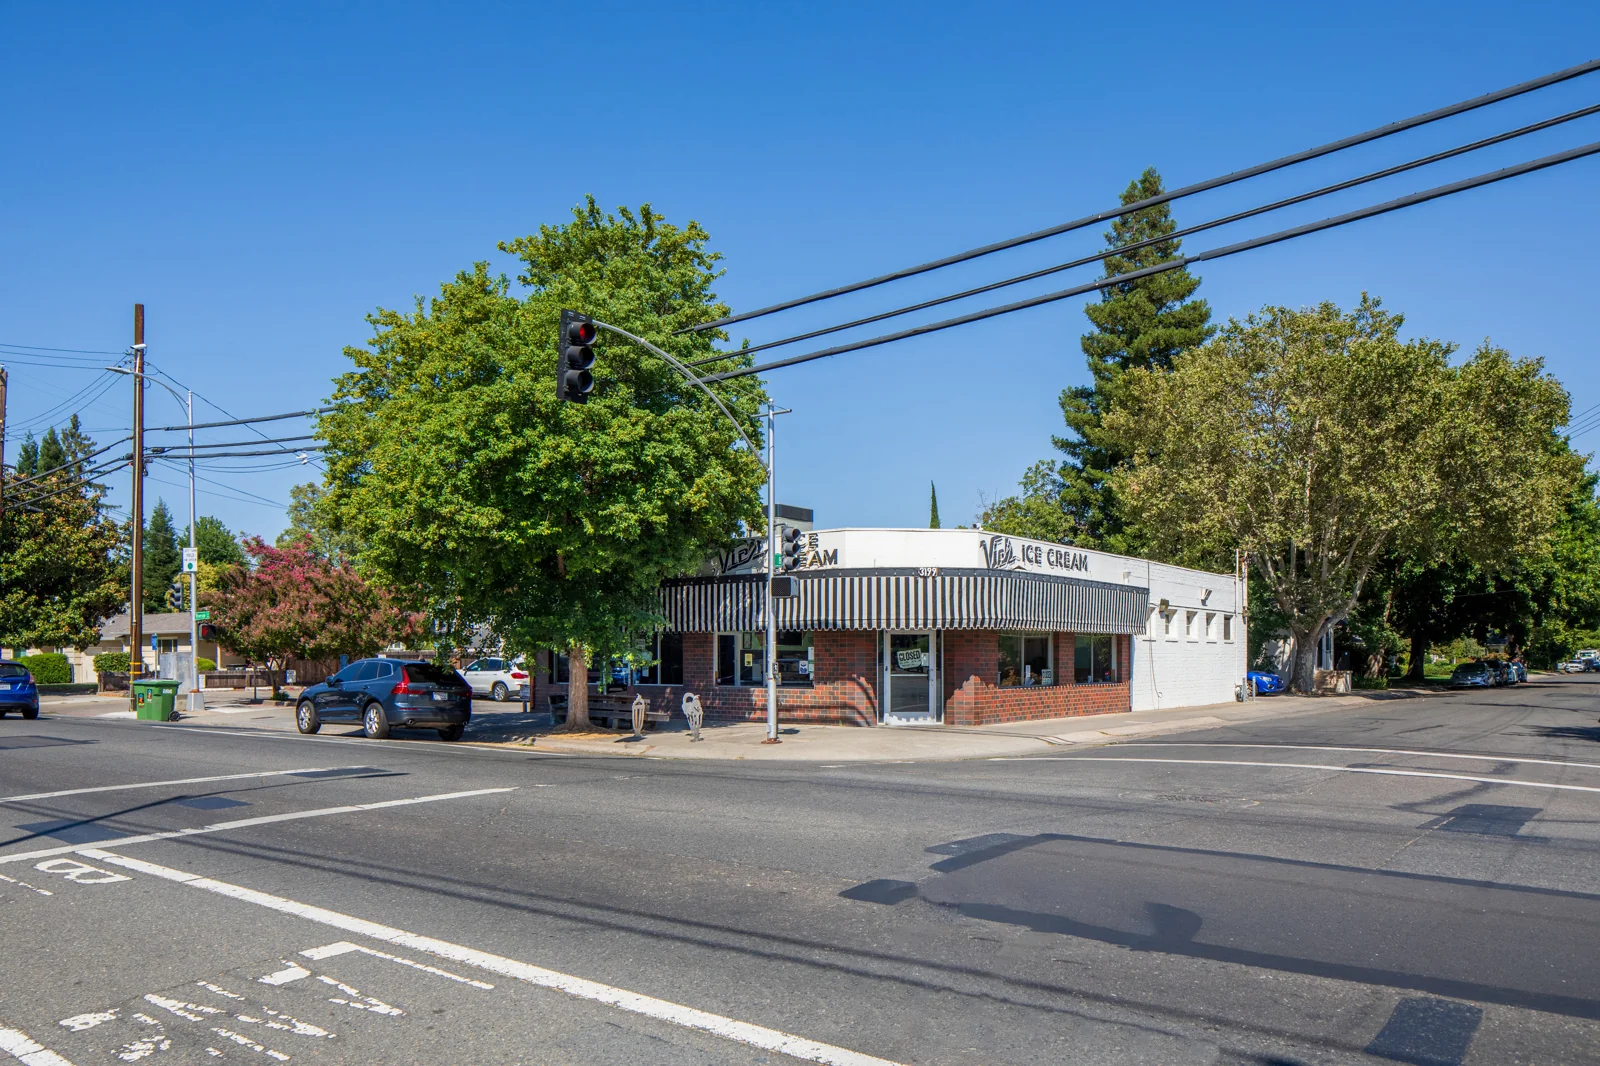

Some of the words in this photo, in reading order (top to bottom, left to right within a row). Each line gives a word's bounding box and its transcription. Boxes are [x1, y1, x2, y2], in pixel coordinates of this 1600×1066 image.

[1022, 544, 1042, 564] ICE
[1047, 548, 1088, 571] CREAM
[919, 567, 937, 577] 3199
[898, 650, 921, 662] CLOSED
